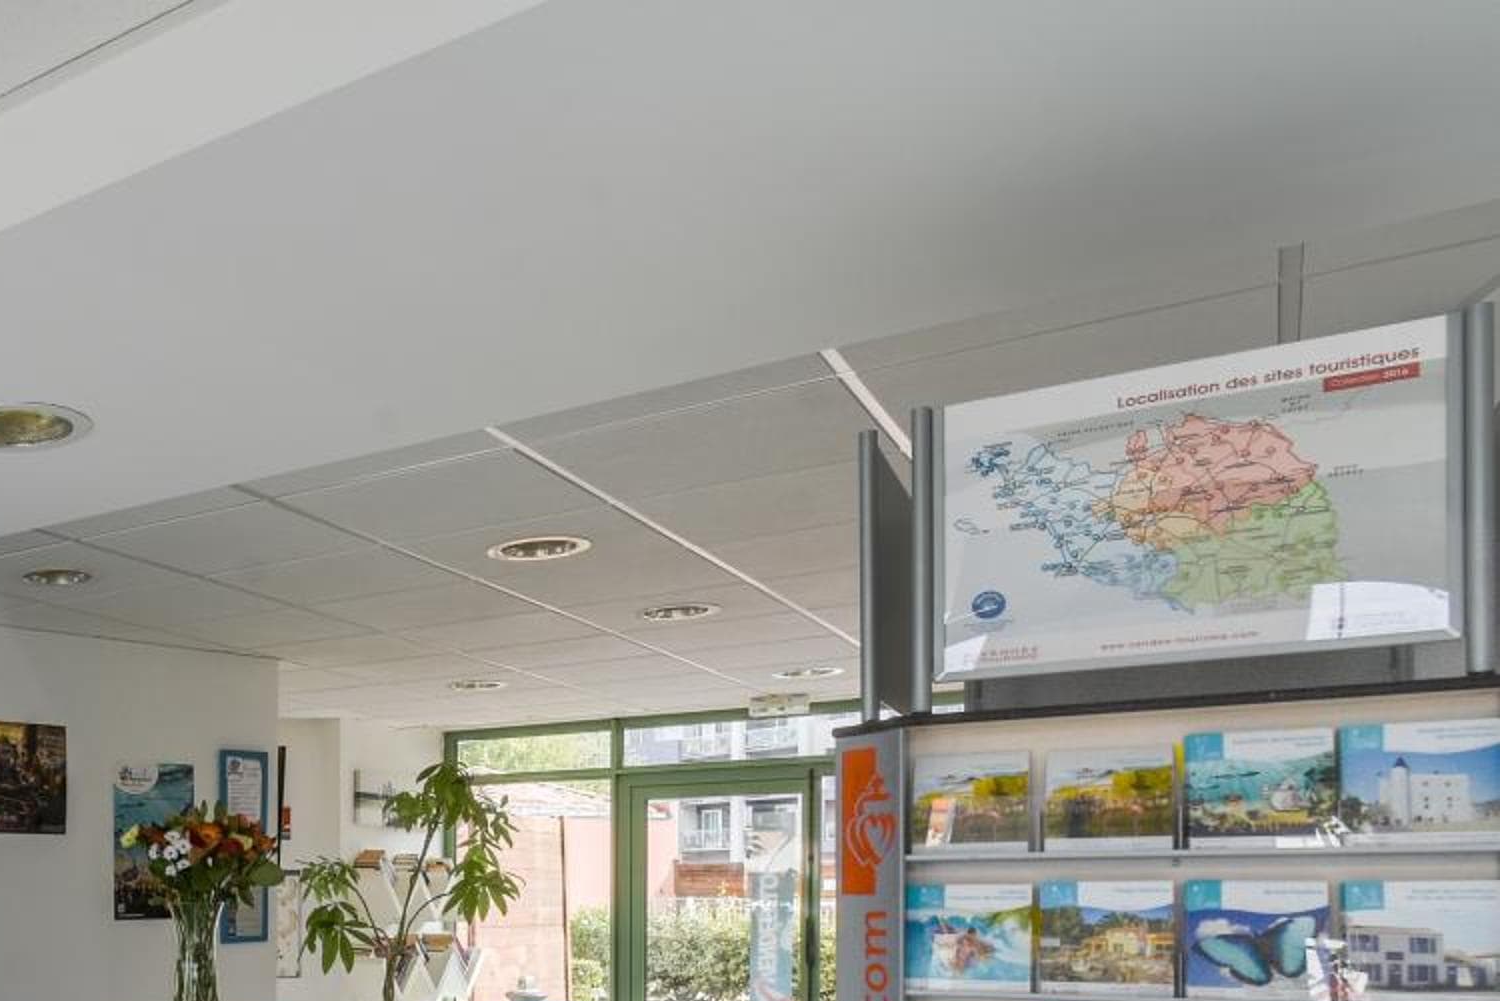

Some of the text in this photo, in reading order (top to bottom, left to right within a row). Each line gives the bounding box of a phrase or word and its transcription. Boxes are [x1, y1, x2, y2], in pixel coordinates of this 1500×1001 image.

[1117, 346, 1421, 409] Localisation des sites touristiques
